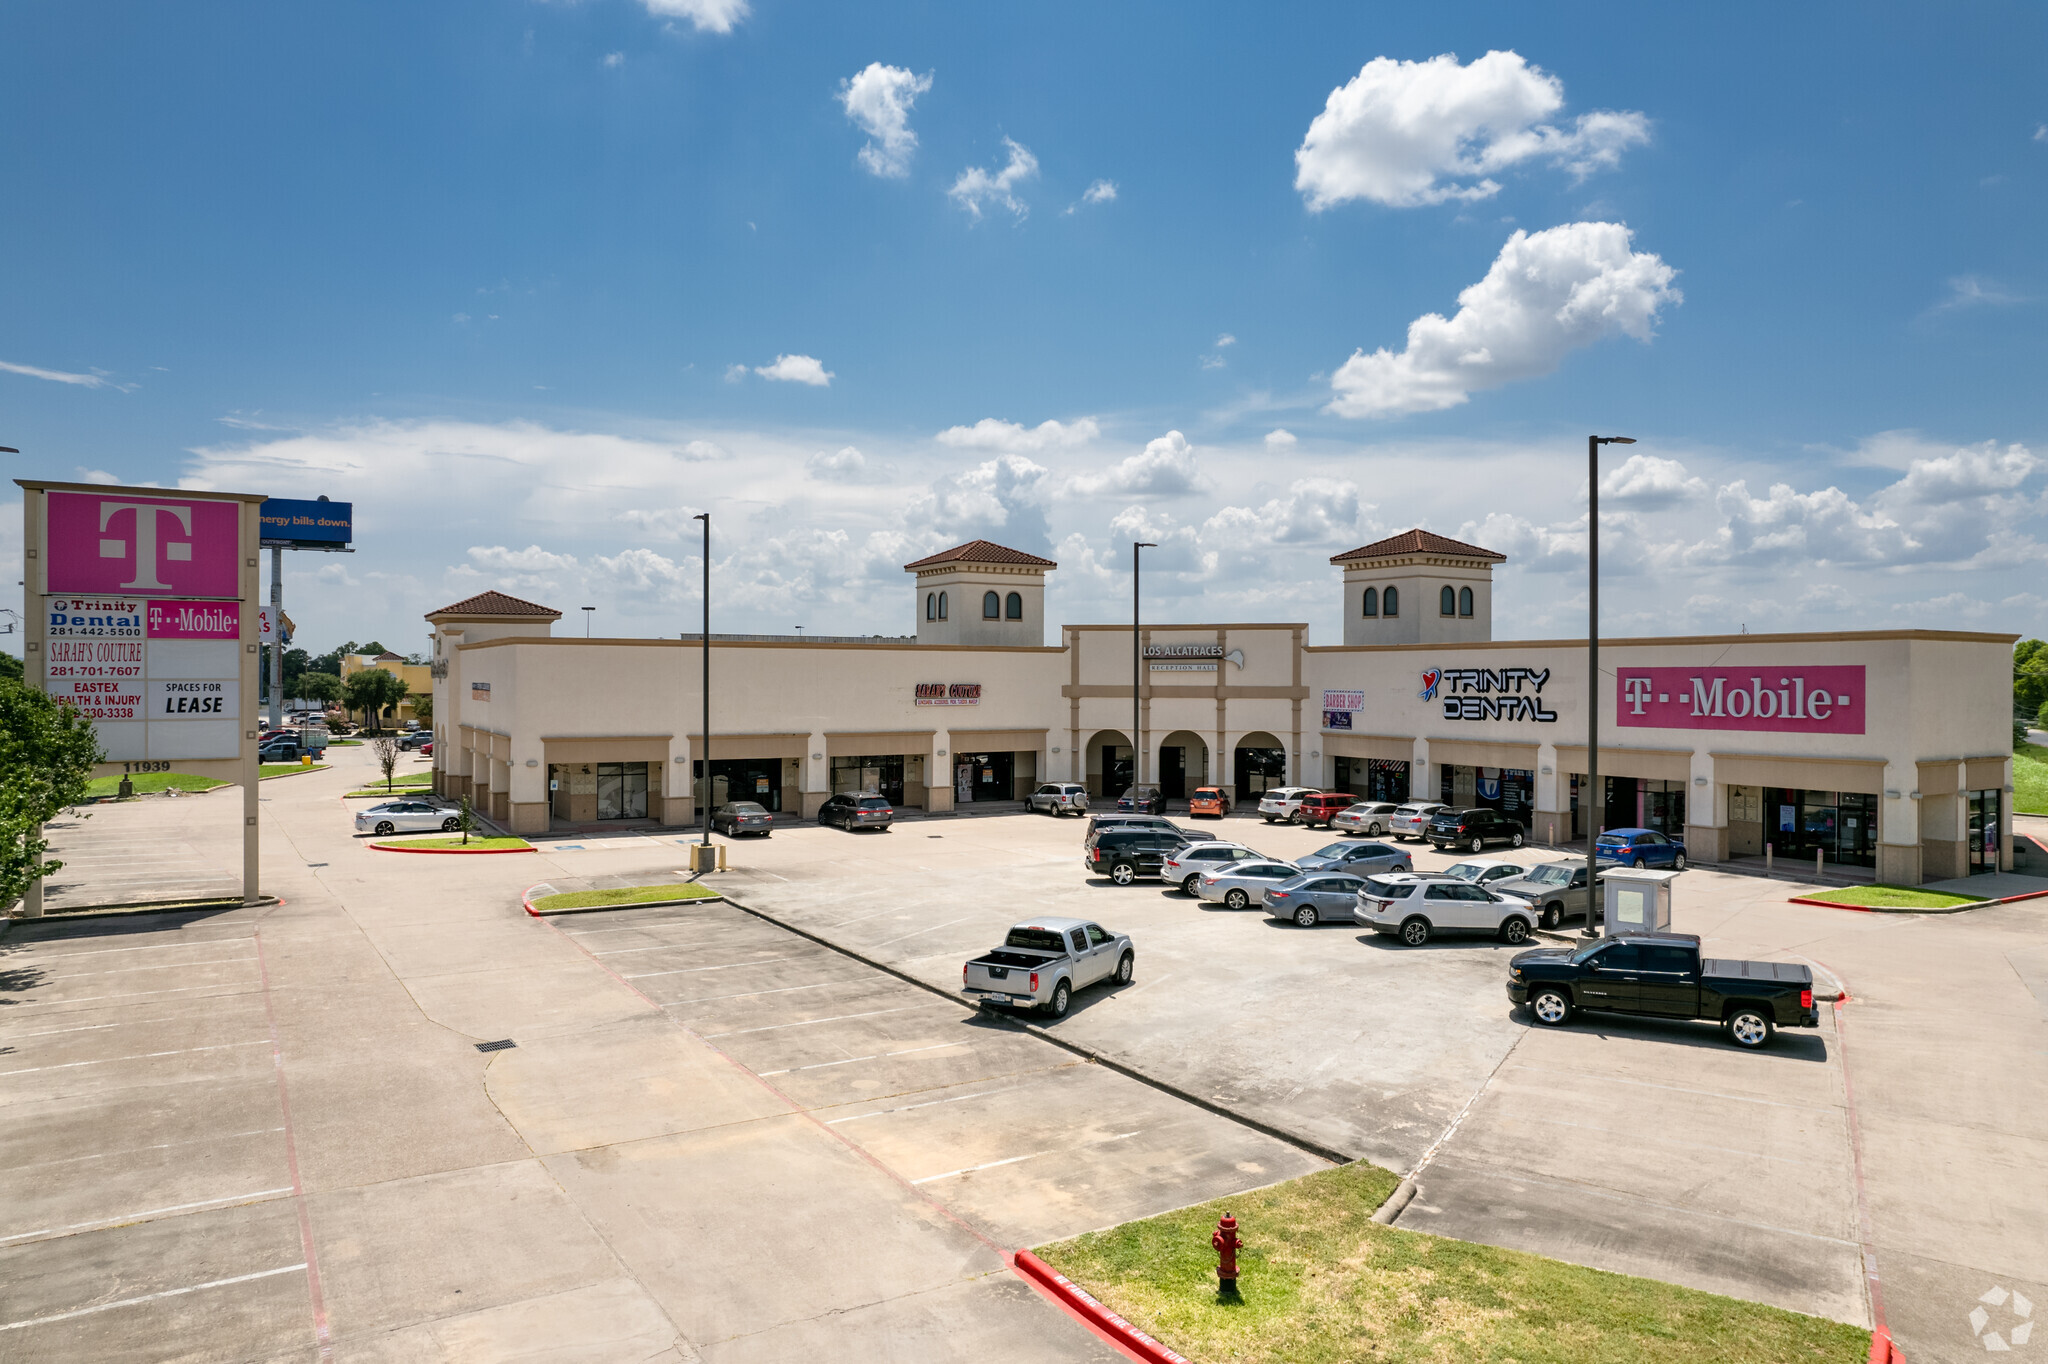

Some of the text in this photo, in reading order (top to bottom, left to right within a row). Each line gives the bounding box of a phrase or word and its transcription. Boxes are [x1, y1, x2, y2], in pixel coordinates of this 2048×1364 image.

[259, 515, 351, 527] nergy bills down.
[100, 501, 192, 590] T
[71, 600, 137, 613] Trinity
[50, 613, 140, 627] Dental
[50, 627, 141, 636] 281-442-5500
[50, 642, 143, 662] SARAH'S COUTURE
[1143, 645, 1223, 656] LOS ALCATRACES
[50, 666, 140, 676] 281-701-7607
[1444, 669, 1549, 692] TRINITY
[74, 682, 119, 693] EASTEX
[166, 683, 221, 692] SPACES FOR
[94, 695, 101, 705] &
[105, 695, 141, 705] INJURY
[166, 697, 223, 713] LEASE
[1443, 697, 1556, 721] DENTAL
[123, 760, 170, 773] 11939
[1106, 1313, 1130, 1329] FIRE
[1128, 1327, 1156, 1346] LANE
[1162, 1349, 1188, 1364] TOW
